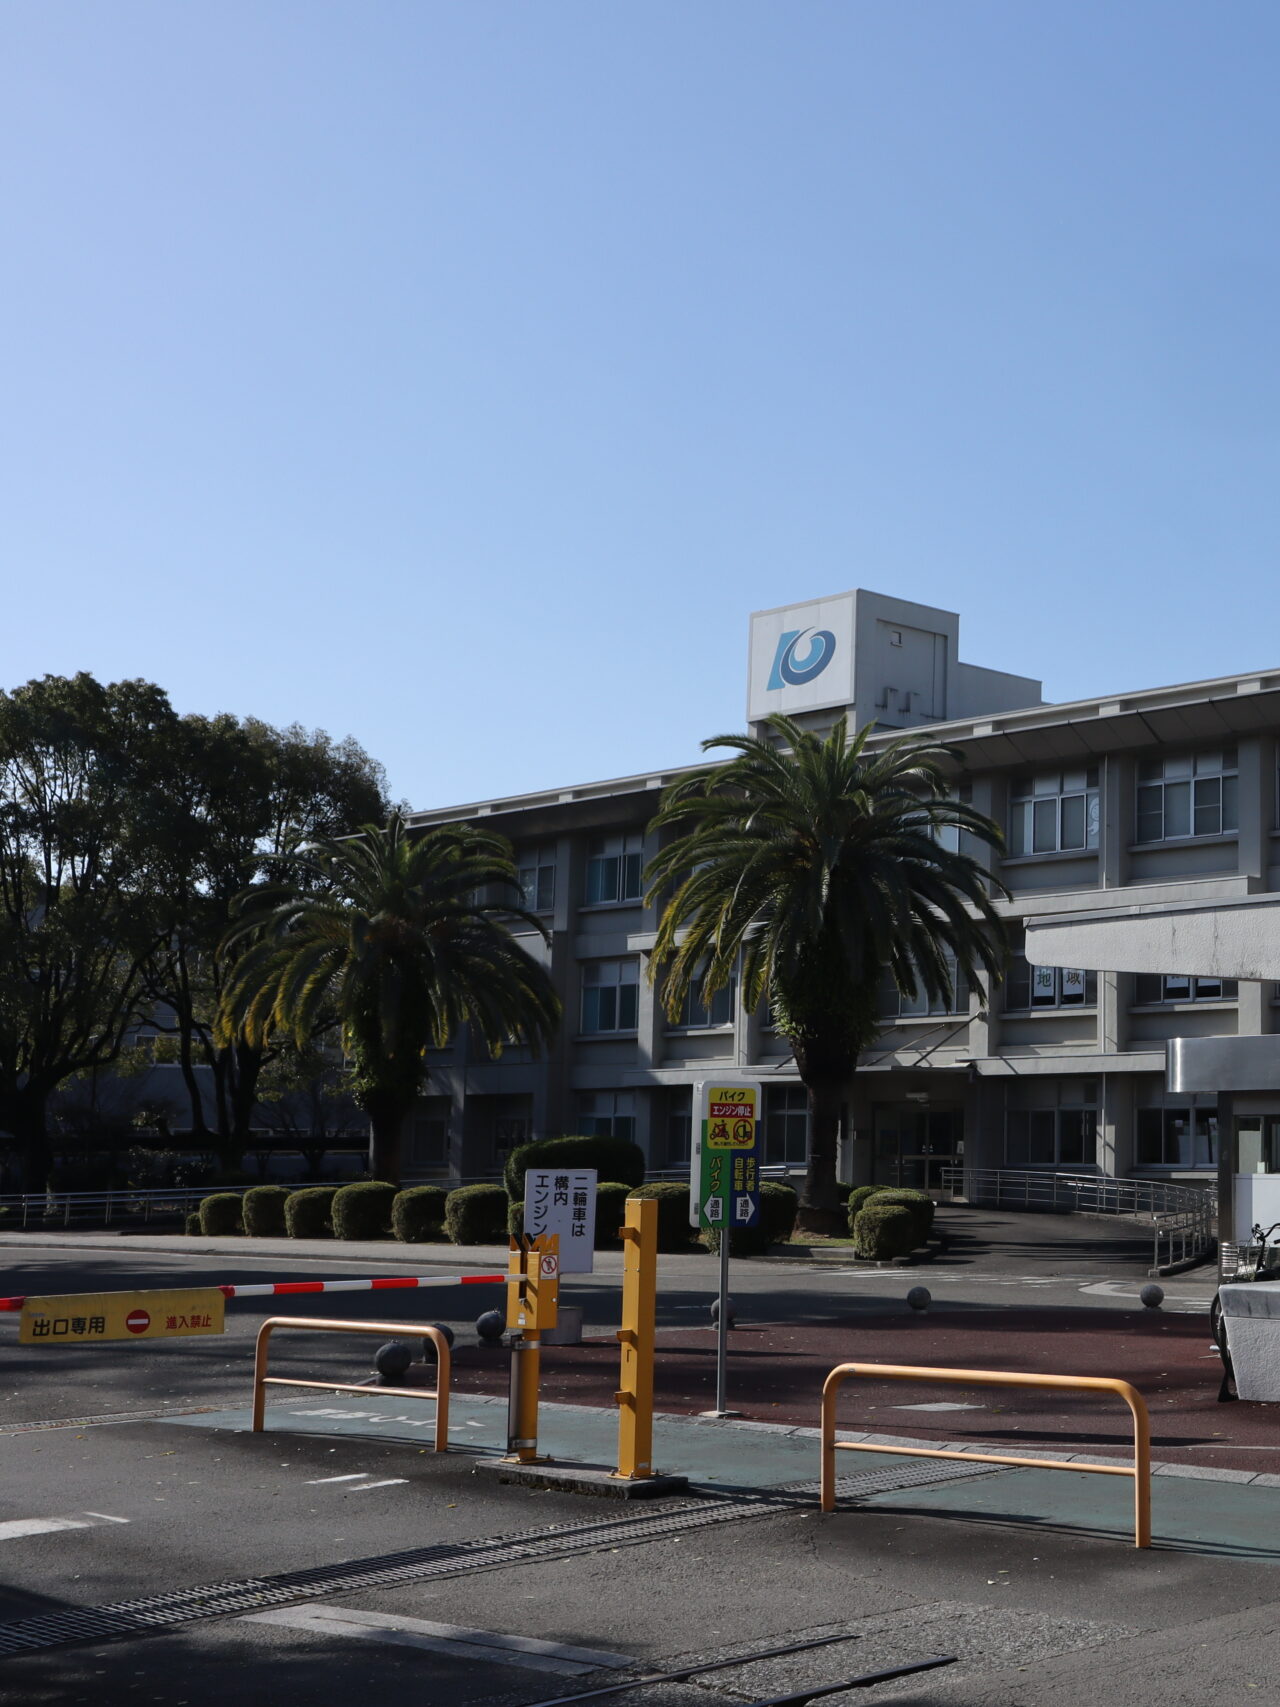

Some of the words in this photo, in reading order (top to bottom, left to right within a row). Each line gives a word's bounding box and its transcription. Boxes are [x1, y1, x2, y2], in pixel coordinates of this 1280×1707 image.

[720, 1091, 745, 1102] バイク
[713, 1105, 751, 1116] エンジン停止
[711, 1157, 722, 1191] バイク
[734, 1158, 743, 1190] 自転車
[746, 1157, 755, 1191] 歩行者
[554, 1176, 569, 1205] 構内
[533, 1175, 549, 1236] エンジン
[572, 1177, 588, 1237] 二輪車は
[710, 1200, 719, 1218] 通路
[740, 1199, 749, 1218] 通路
[32, 1316, 105, 1337] 出口専用
[165, 1314, 212, 1330] 進入禁止
